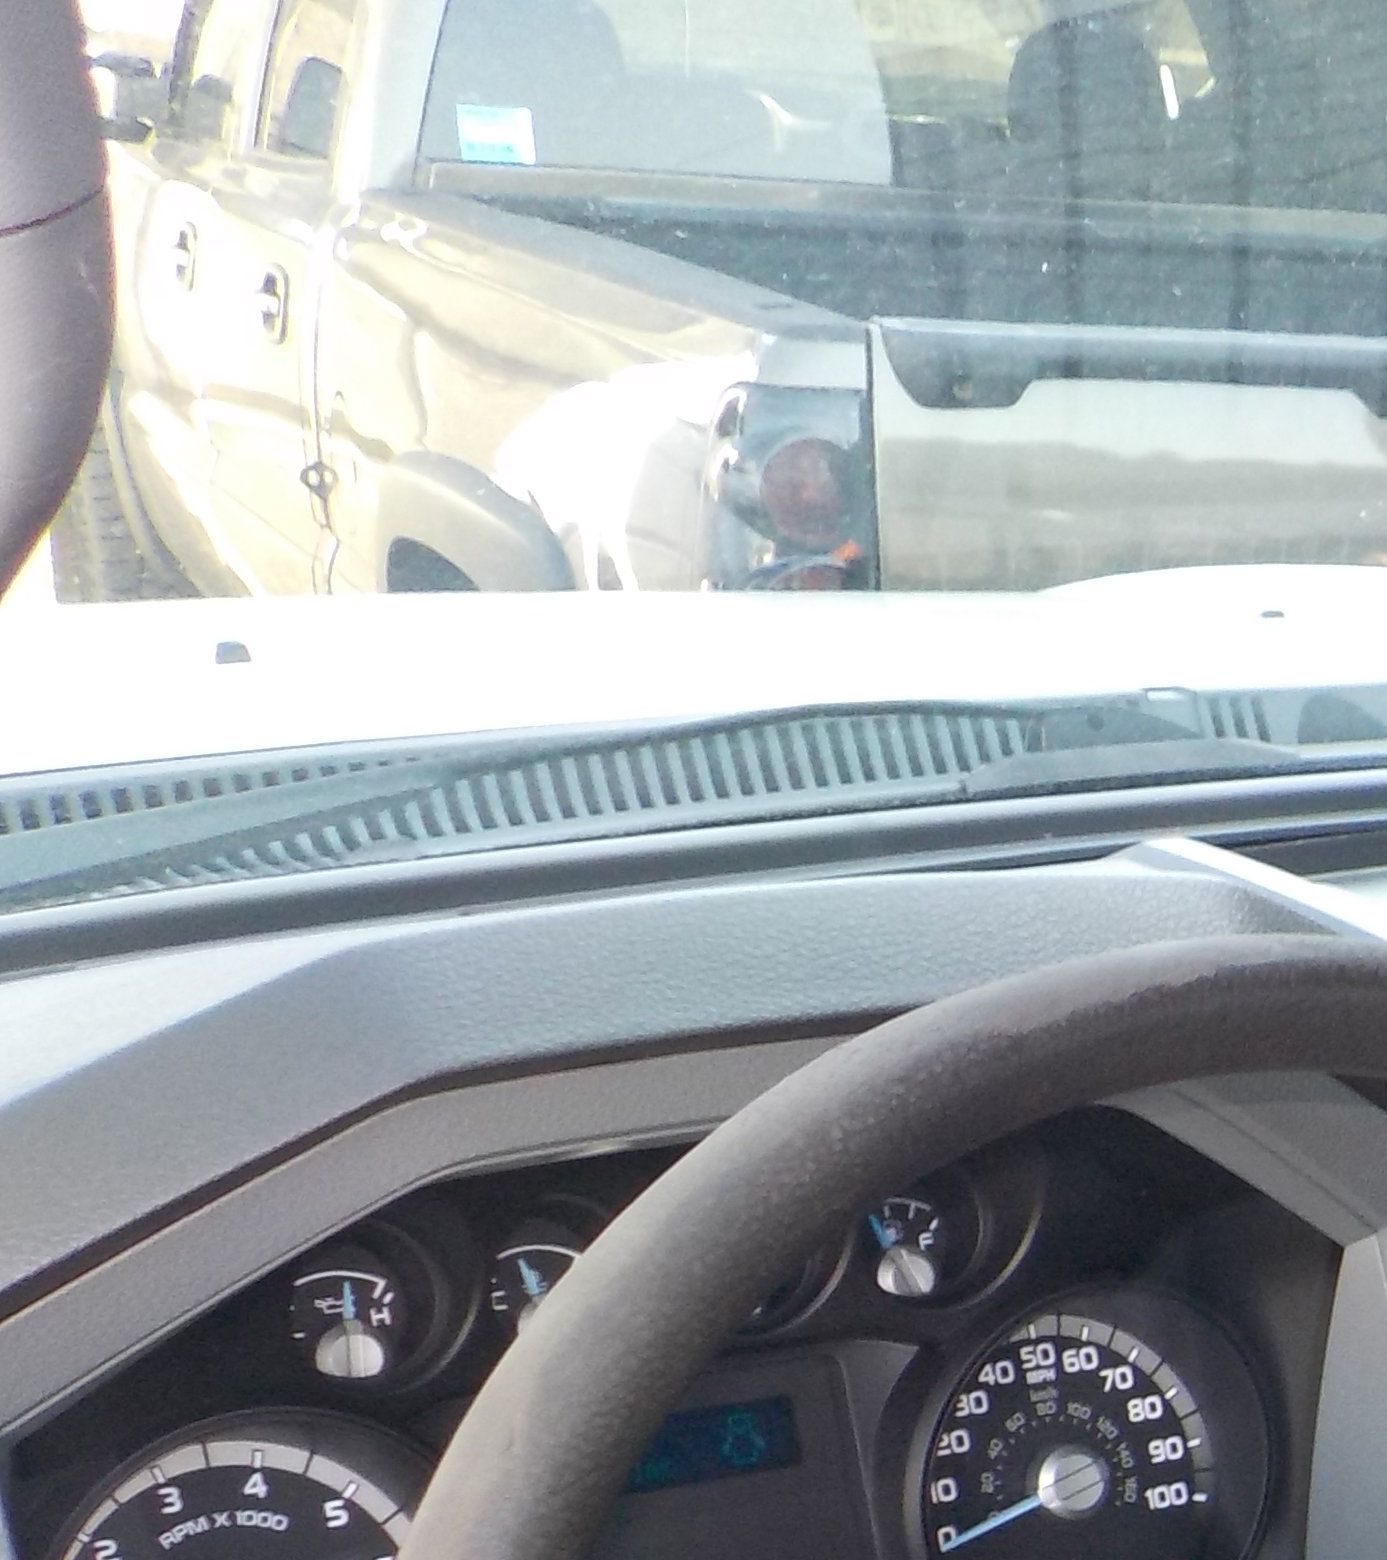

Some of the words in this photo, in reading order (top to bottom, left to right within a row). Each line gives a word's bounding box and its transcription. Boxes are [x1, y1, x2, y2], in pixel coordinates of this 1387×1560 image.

[919, 1231, 934, 1251] F
[369, 1307, 392, 1326] H
[1019, 1342, 1056, 1370] 50
[1062, 1345, 1099, 1374] 60
[978, 1360, 1015, 1386] 40
[1026, 1367, 1056, 1385] MPH
[1099, 1365, 1134, 1393] 70
[954, 1390, 989, 1417] 30
[1127, 1394, 1163, 1423] 80
[937, 1429, 971, 1457] 20
[1148, 1435, 1184, 1463] 90
[243, 1472, 268, 1498] 4
[930, 1477, 958, 1504] 10
[1144, 1481, 1188, 1511] 100
[157, 1486, 184, 1514] 3
[323, 1500, 349, 1528] 5
[158, 1516, 210, 1550] RPM
[212, 1512, 232, 1528] X
[236, 1510, 290, 1531] 1000
[937, 1525, 957, 1552] 0
